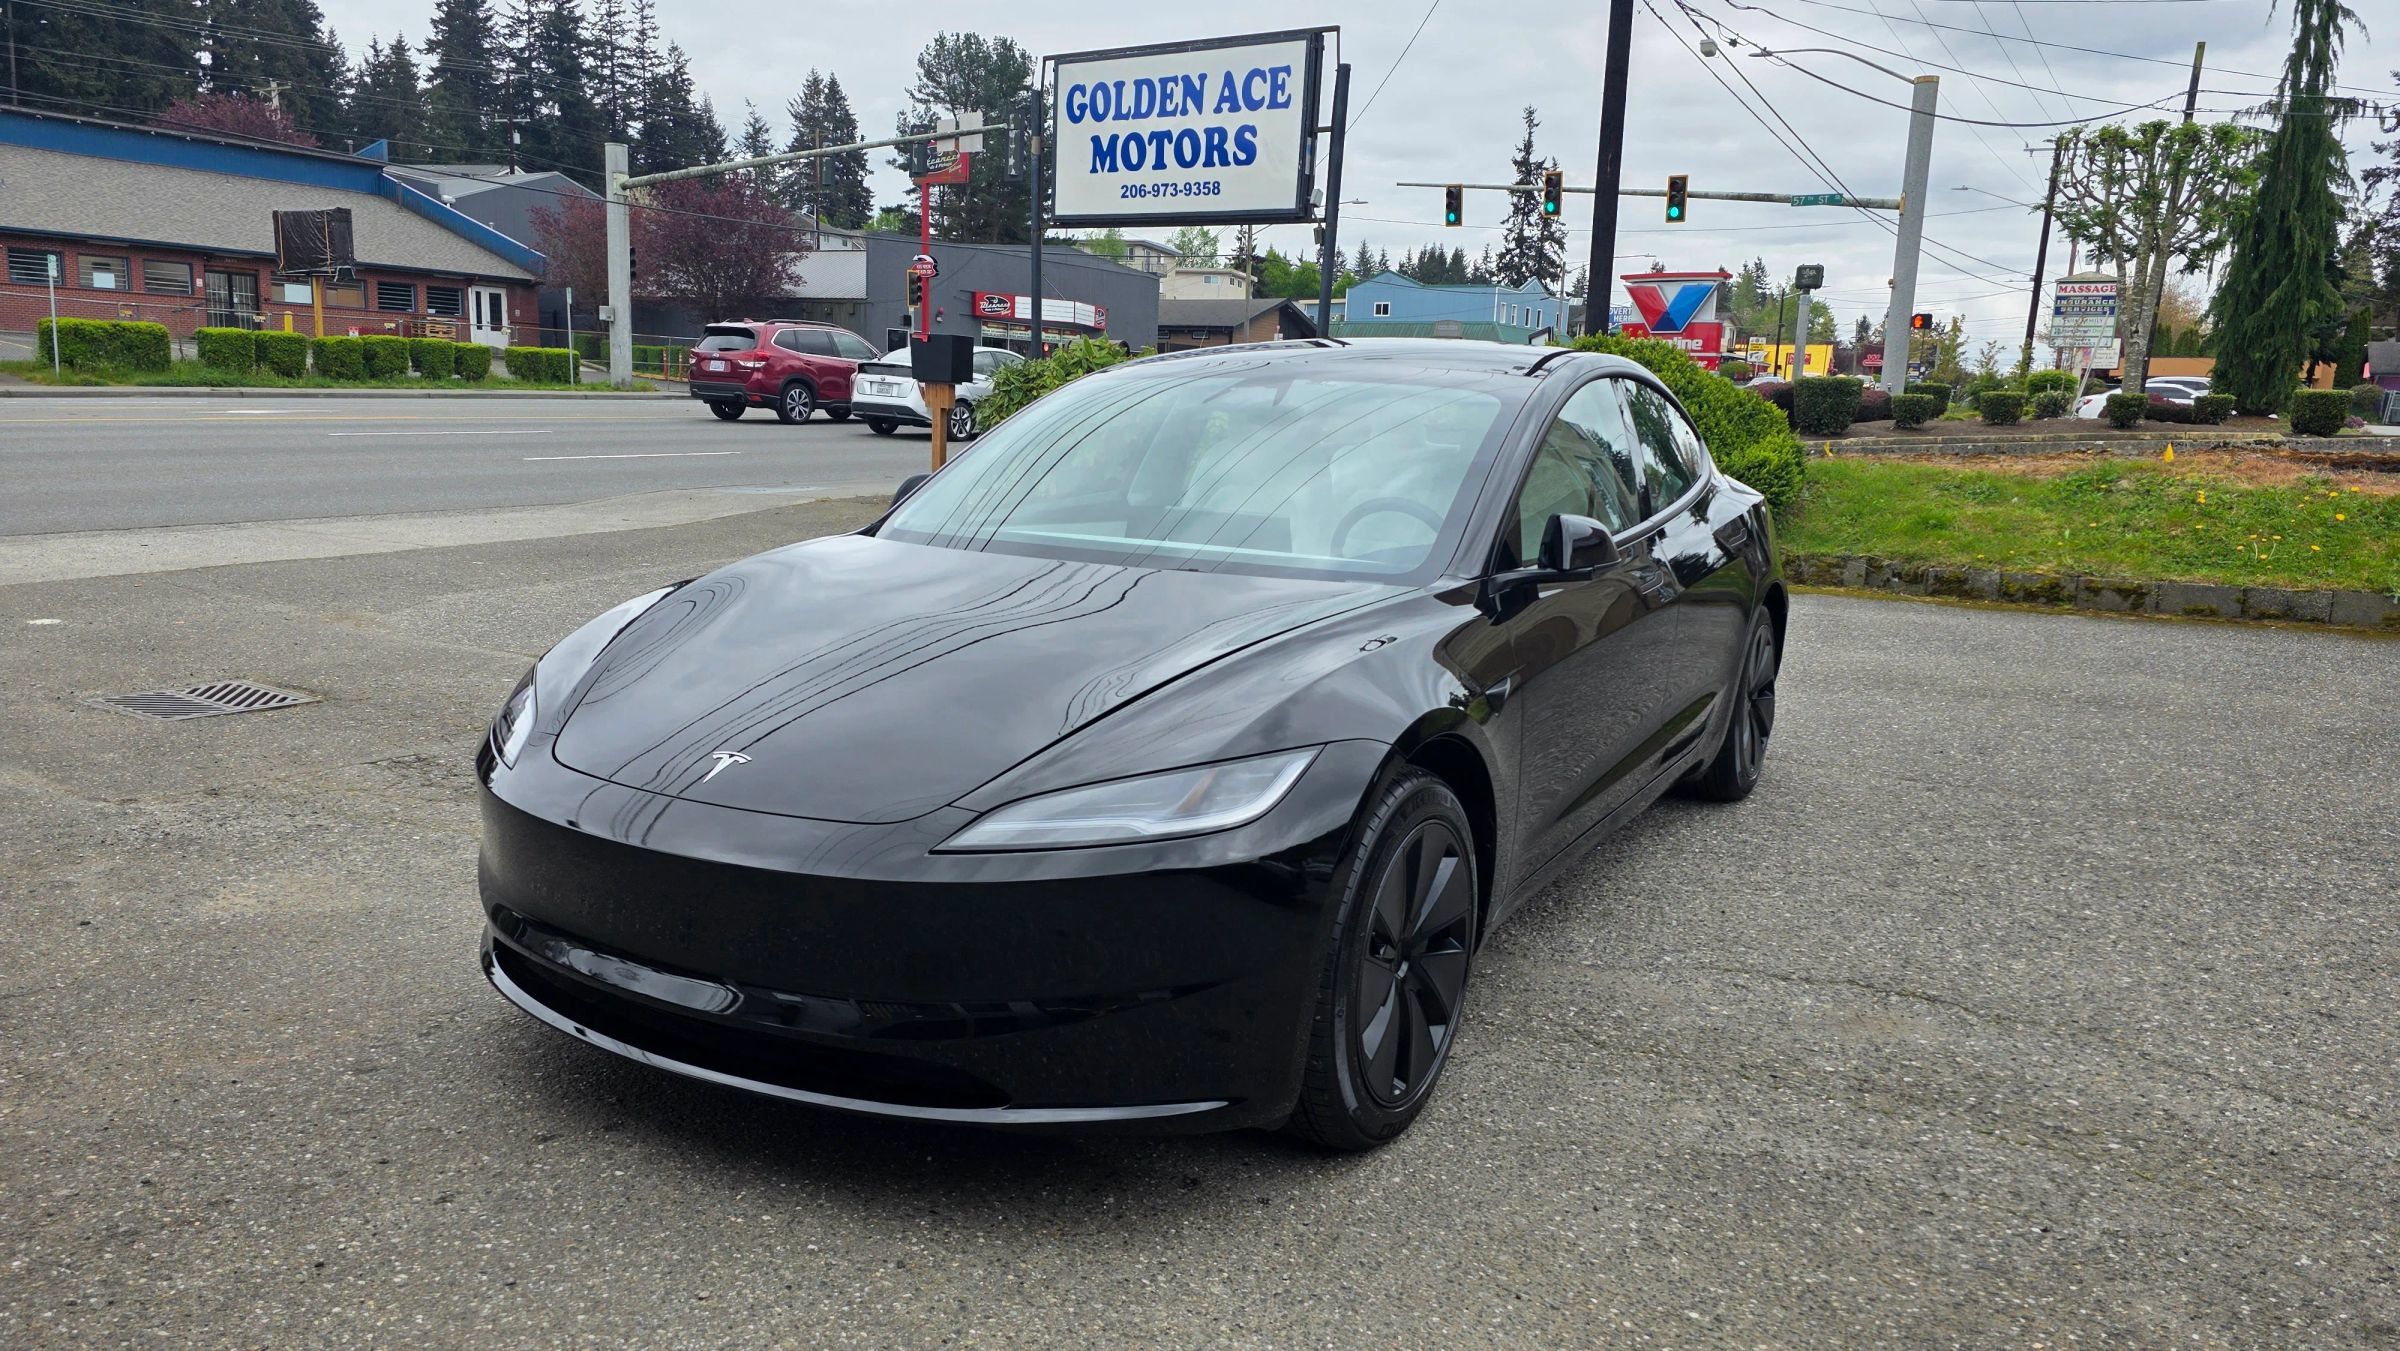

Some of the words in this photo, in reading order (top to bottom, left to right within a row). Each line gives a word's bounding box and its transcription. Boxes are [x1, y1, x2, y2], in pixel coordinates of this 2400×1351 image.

[1066, 72, 1208, 124] GOLDEN
[1212, 64, 1292, 115] ACE
[1089, 124, 1258, 174] MOTORS
[1120, 180, 1221, 199] 206-973-9358
[1818, 195, 1829, 205] ST
[2058, 285, 2117, 294] MASSAGE
